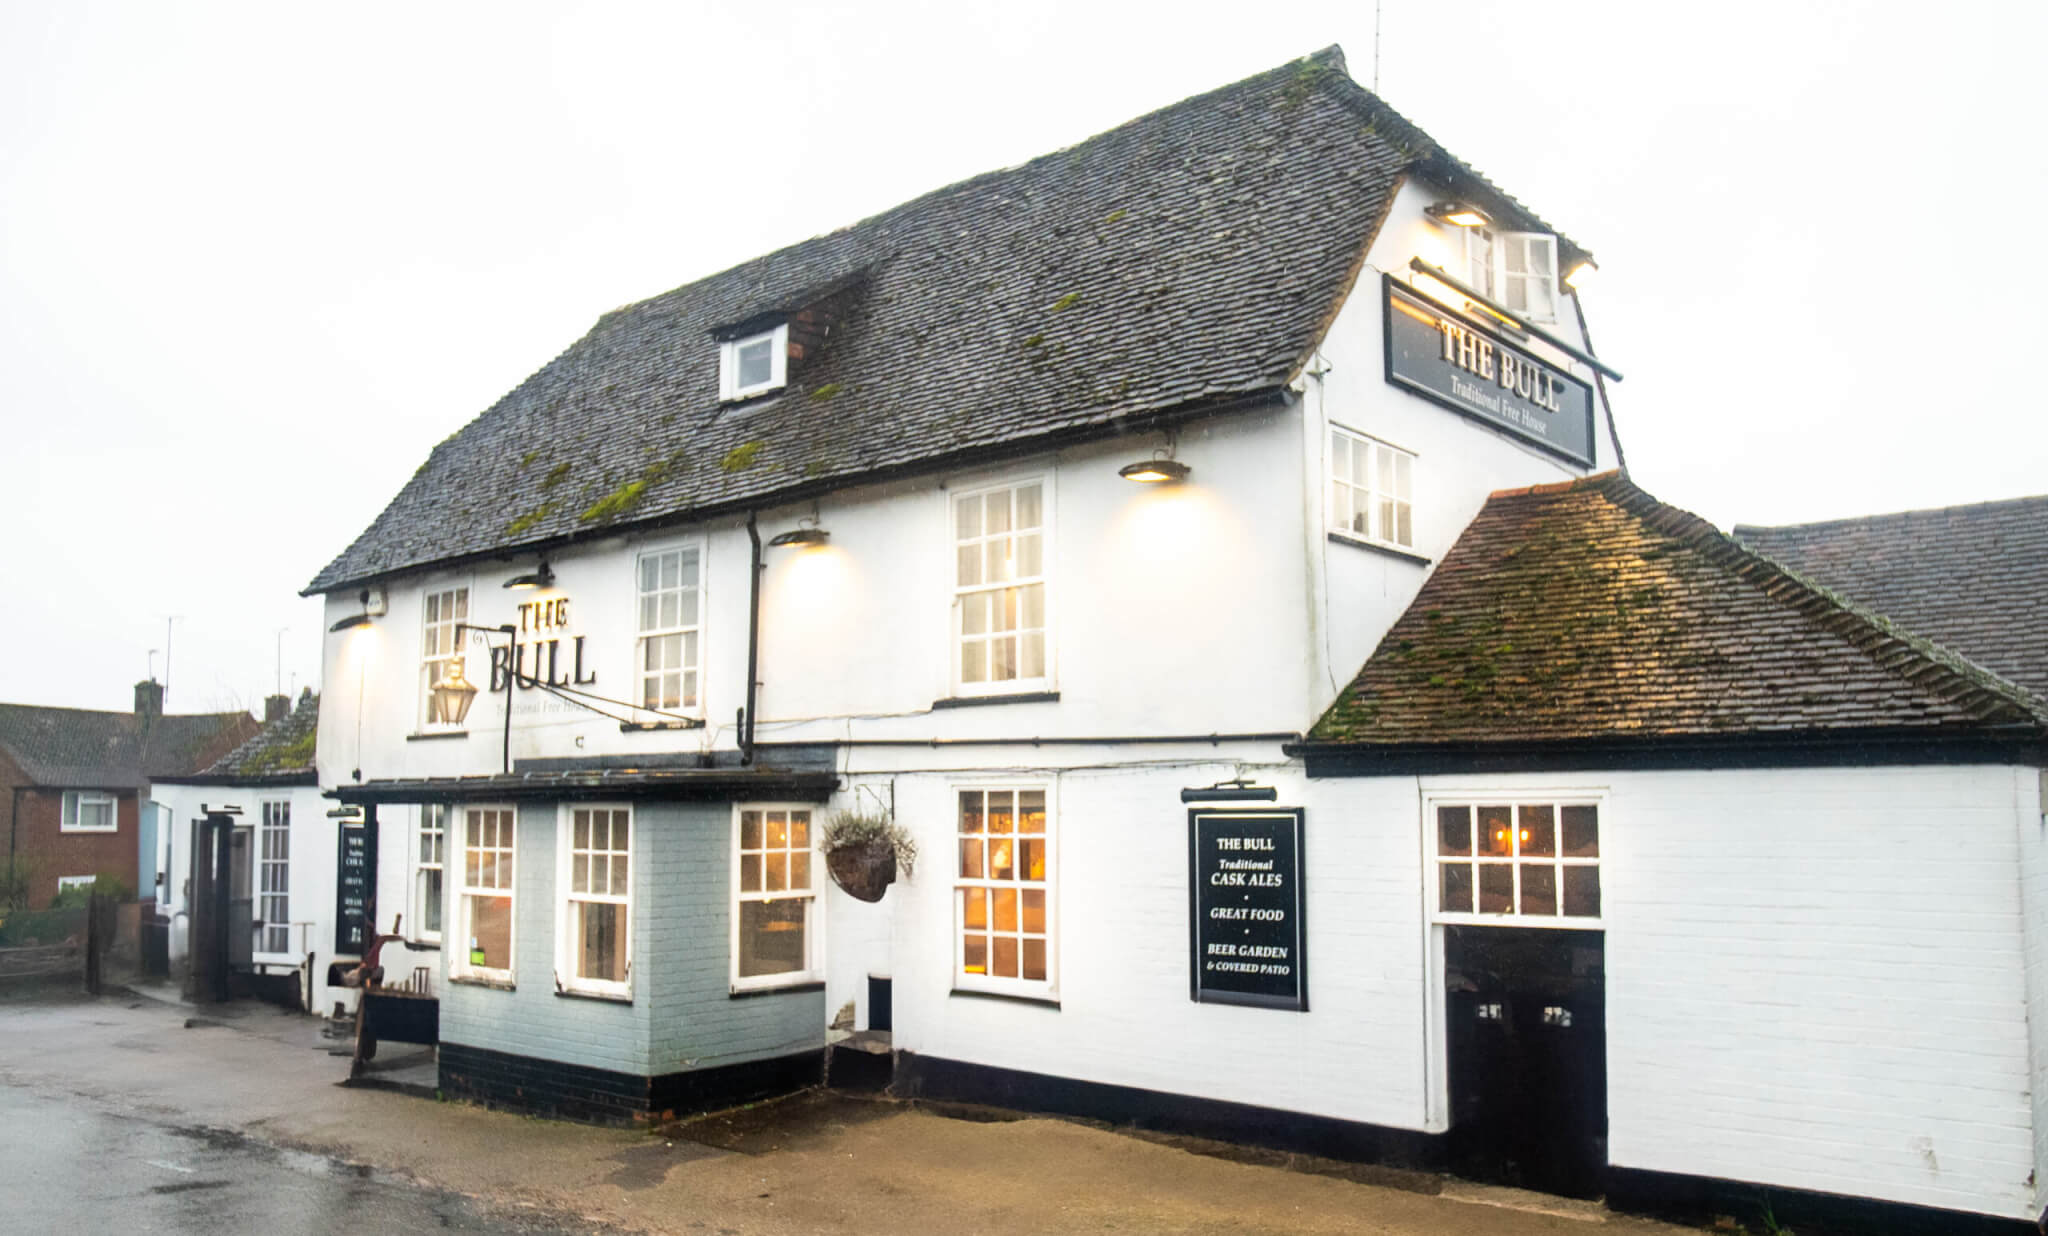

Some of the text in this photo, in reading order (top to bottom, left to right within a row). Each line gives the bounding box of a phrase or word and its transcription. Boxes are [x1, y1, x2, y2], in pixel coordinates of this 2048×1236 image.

[1440, 318, 1560, 413] THE BULL
[1450, 374, 1548, 435] Traditional Free House
[518, 597, 570, 632] THE
[489, 635, 596, 692] BULL
[1216, 838, 1276, 851] THE BULL
[1219, 859, 1274, 871] Traditional
[1210, 872, 1283, 887] CASK ALES
[1210, 907, 1285, 921] GREAT FOOD
[1207, 943, 1288, 959] BEER GARDEN
[1206, 961, 1291, 976] & COVERED PATIO
